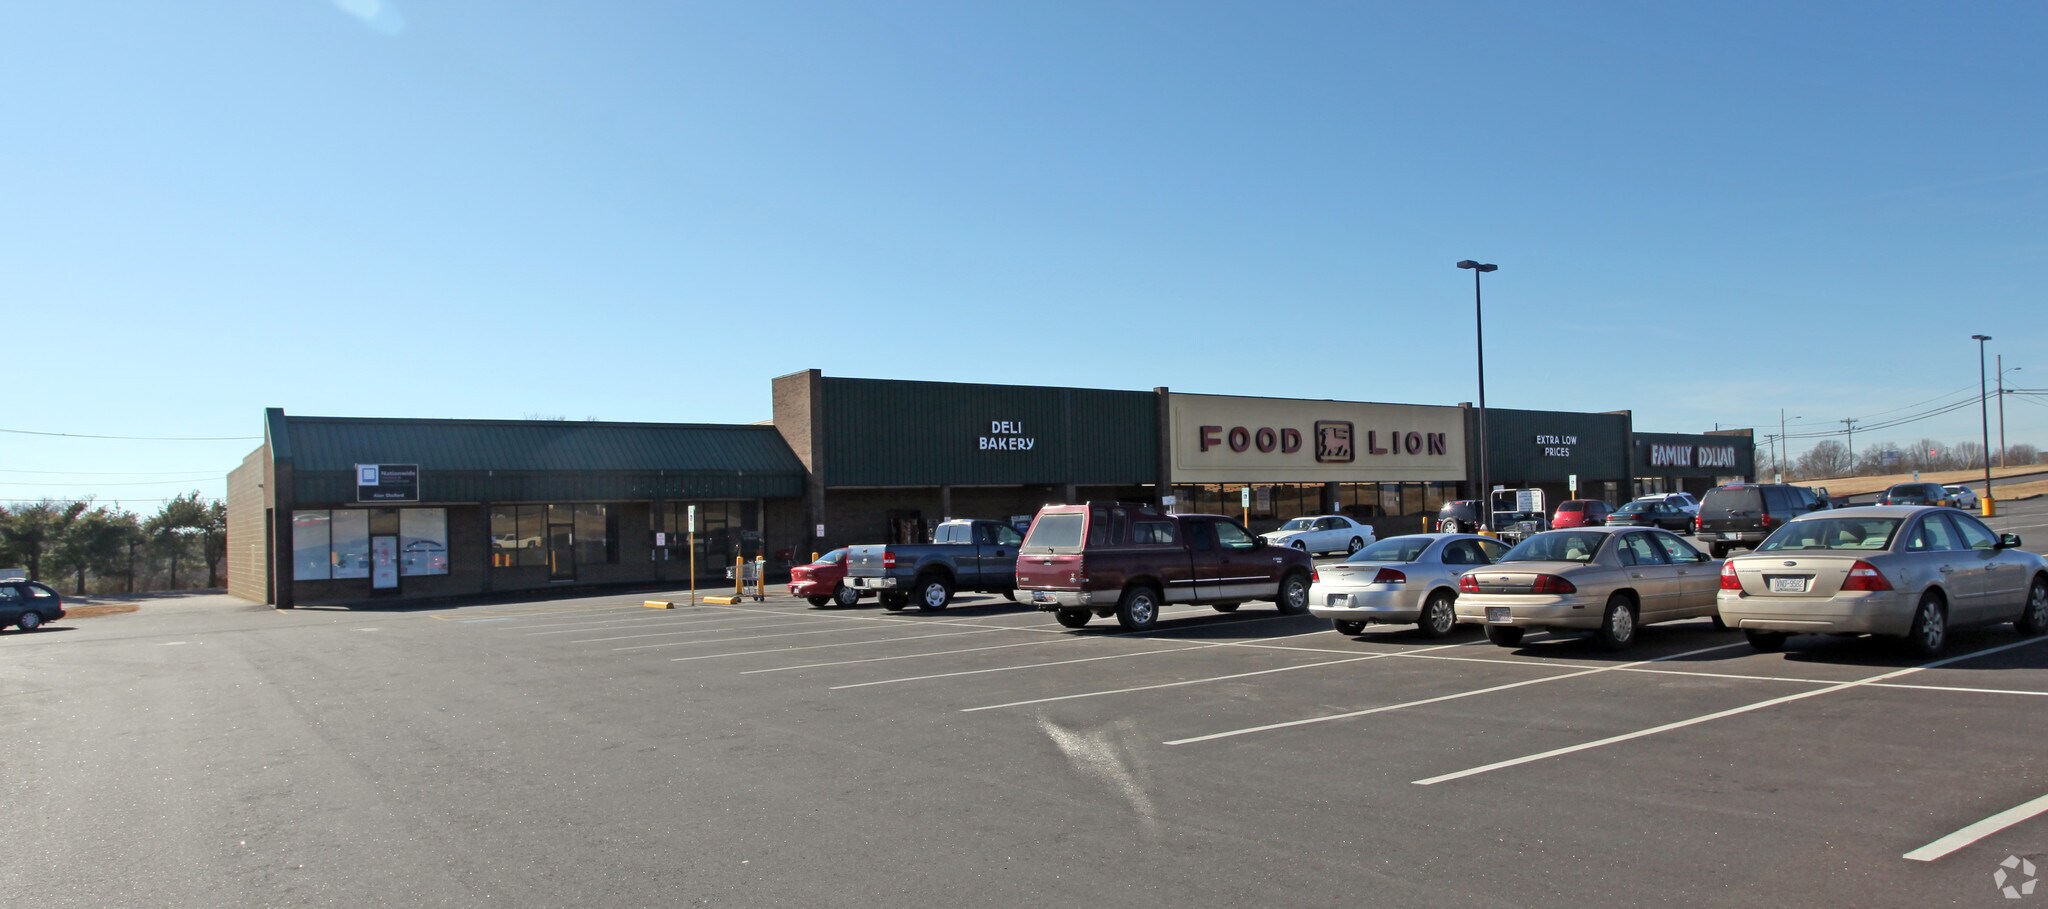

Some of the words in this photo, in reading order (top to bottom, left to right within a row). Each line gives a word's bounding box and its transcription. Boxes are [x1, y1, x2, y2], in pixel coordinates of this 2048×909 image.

[991, 420, 1022, 434] DELI
[979, 436, 1035, 450] BAKERY
[1199, 425, 1303, 454] FOOD
[1368, 430, 1447, 456] LION
[1536, 435, 1560, 445] EXTRA
[1561, 435, 1577, 445] LOW
[1544, 447, 1570, 457] PRICES
[1651, 444, 1693, 467] FAMILY
[1698, 446, 1736, 468] DOLLAR
